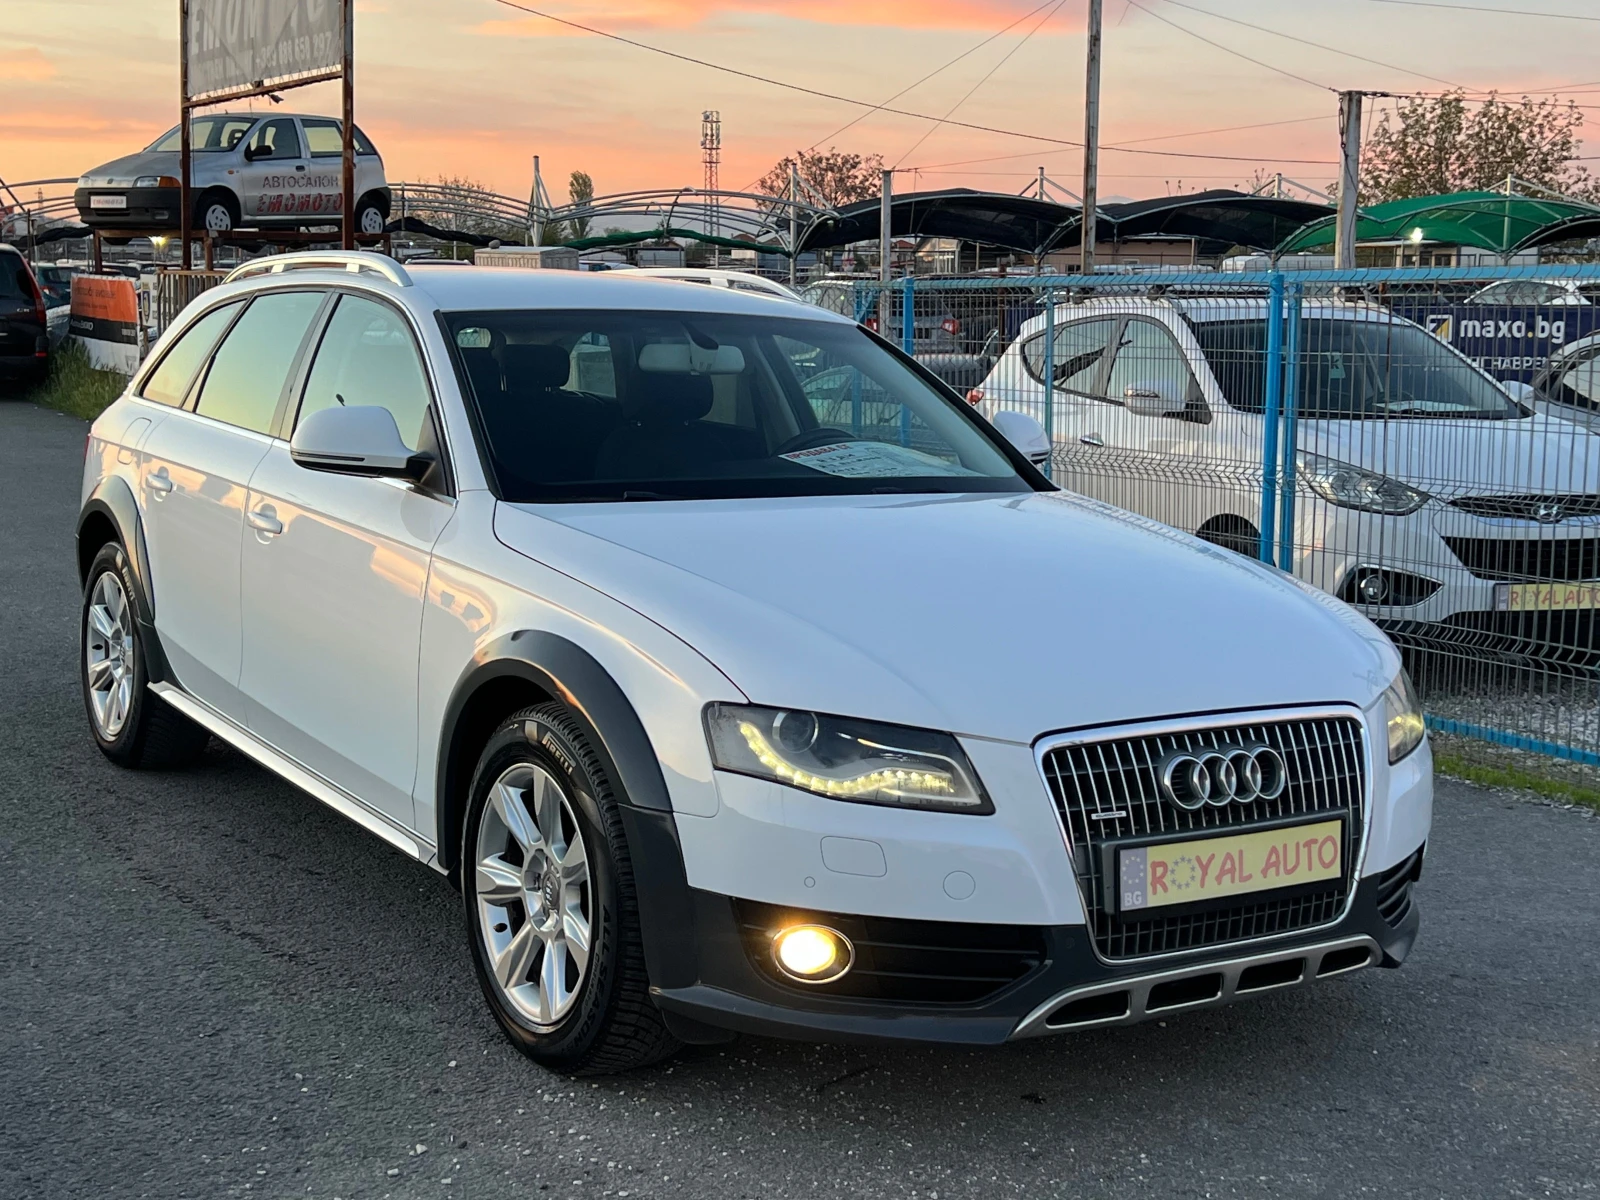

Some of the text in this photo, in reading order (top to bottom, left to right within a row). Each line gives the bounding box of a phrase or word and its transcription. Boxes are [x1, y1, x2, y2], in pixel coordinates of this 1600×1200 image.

[262, 174, 339, 189] АВТОСАЛОН
[1460, 315, 1565, 344] maxo.bg
[542, 731, 577, 775] PIRELLI
[1261, 835, 1338, 879] AUTO
[1124, 891, 1142, 906] BG
